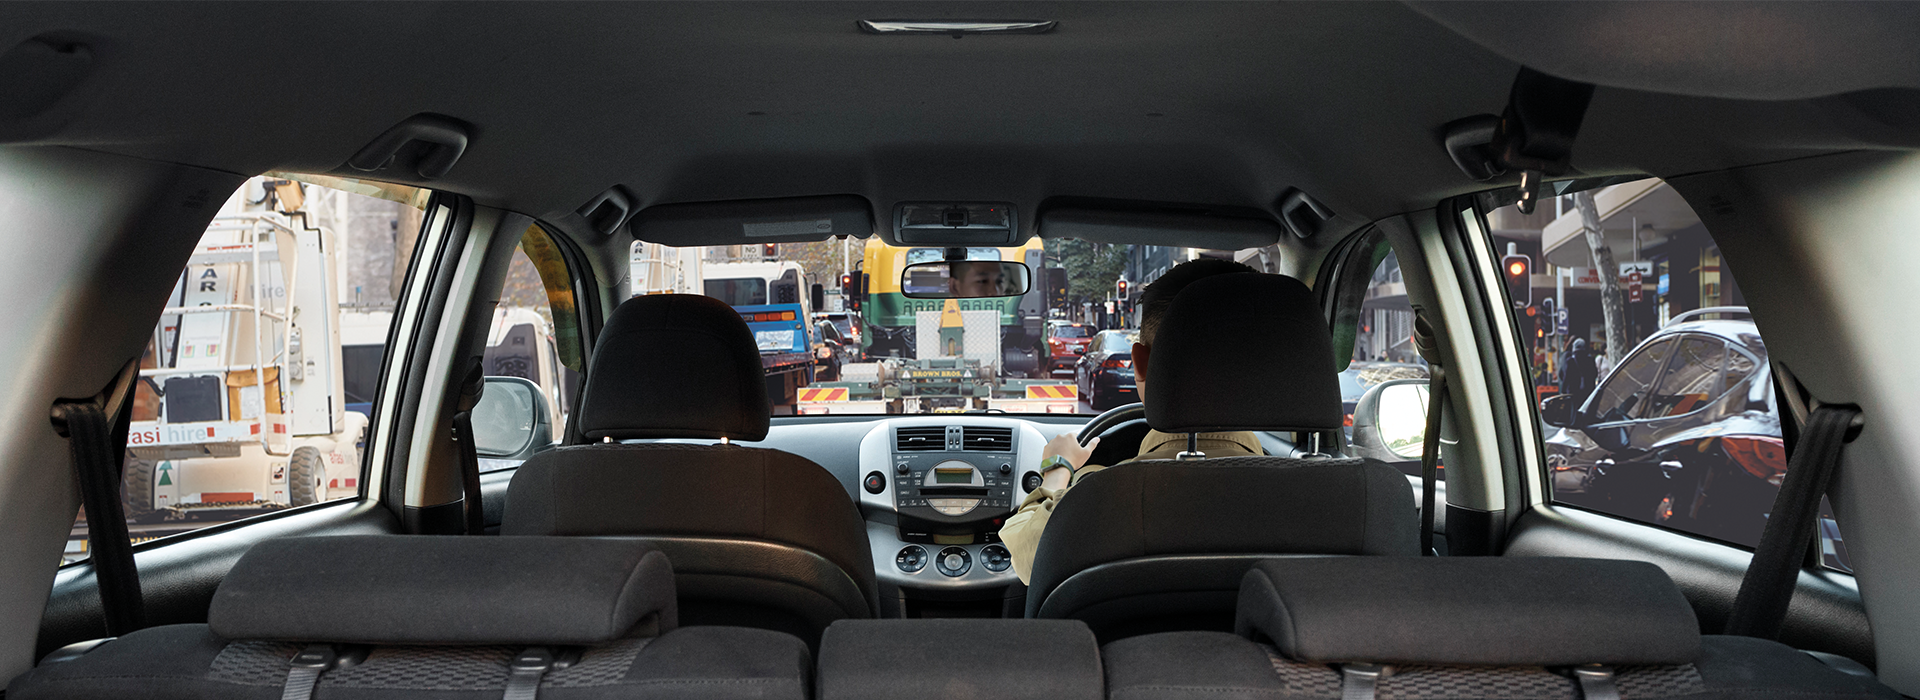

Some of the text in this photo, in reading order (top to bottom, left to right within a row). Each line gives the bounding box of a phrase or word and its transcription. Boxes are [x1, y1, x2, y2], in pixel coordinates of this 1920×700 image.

[745, 246, 757, 254] NO
[1559, 310, 1567, 324] P
[912, 370, 940, 378] BROWN
[127, 425, 206, 445] asi hire
